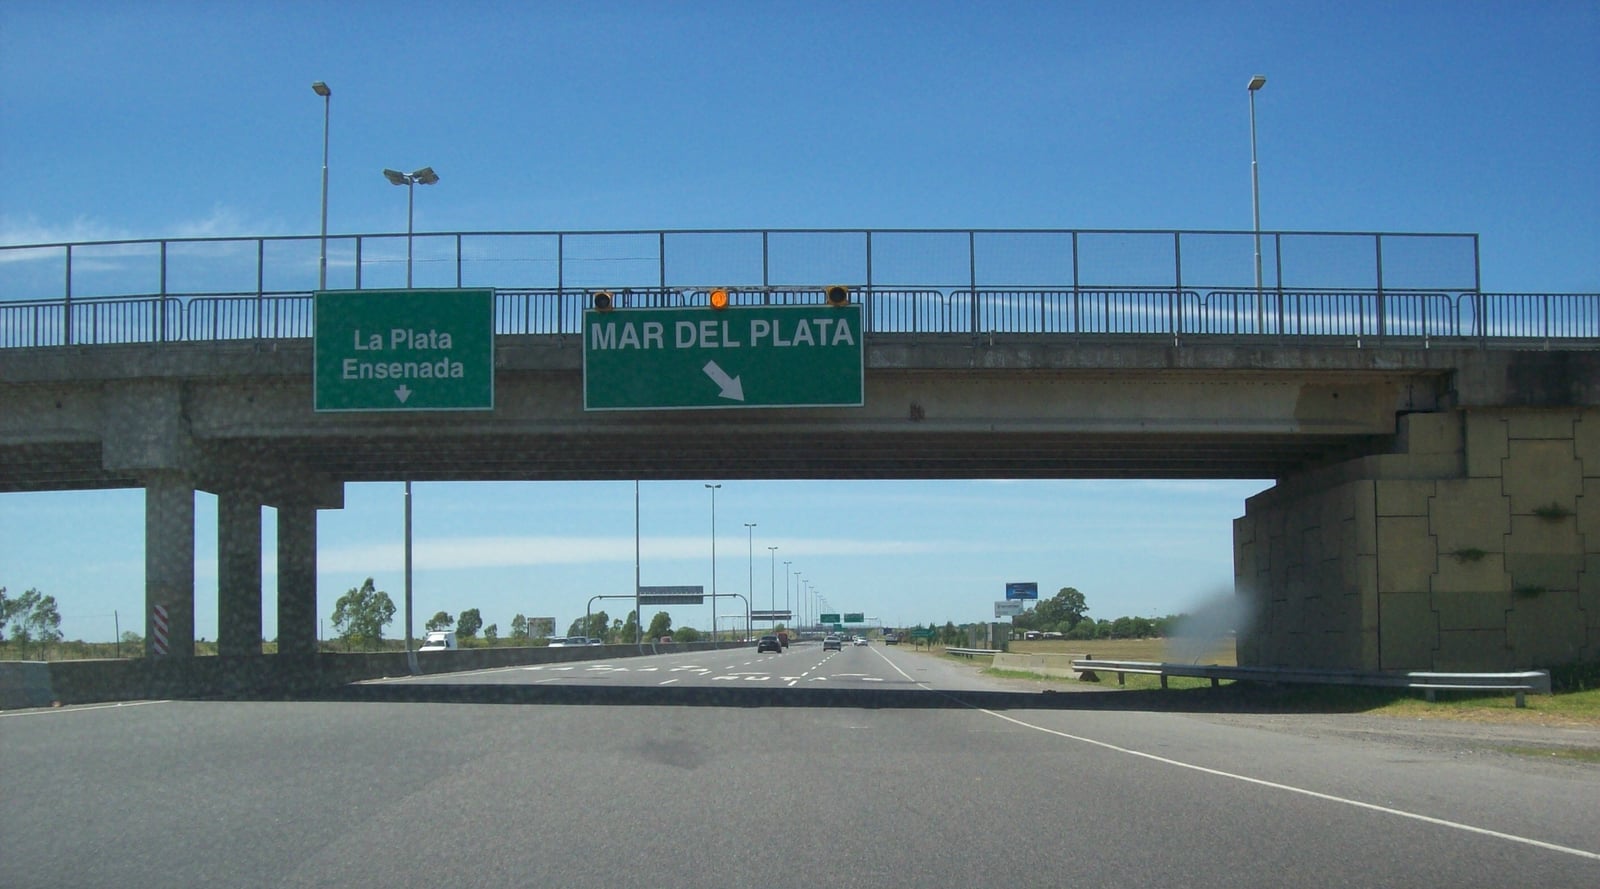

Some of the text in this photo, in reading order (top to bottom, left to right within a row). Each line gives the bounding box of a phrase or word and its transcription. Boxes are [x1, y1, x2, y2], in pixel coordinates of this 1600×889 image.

[355, 330, 451, 350] La Plata
[592, 319, 854, 349] MAR DEL PLATA
[344, 358, 463, 378] Ensenada
